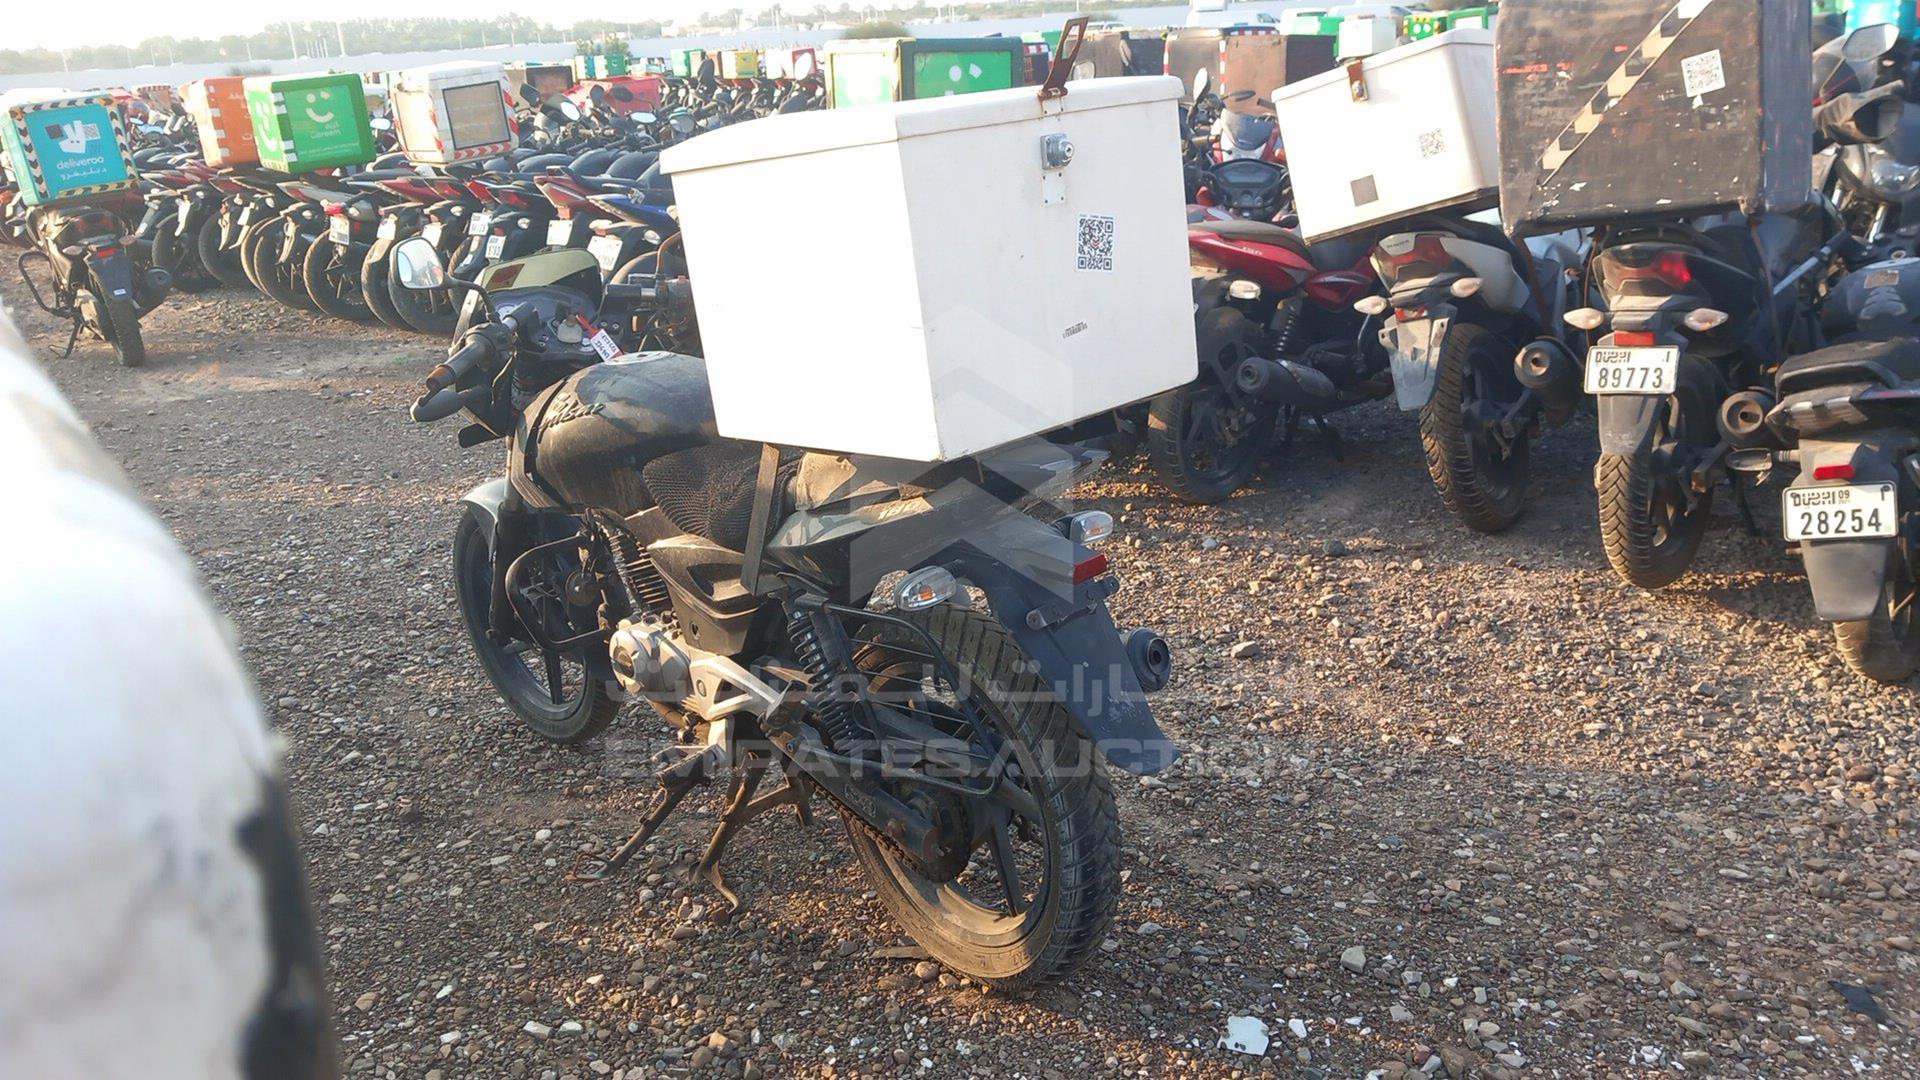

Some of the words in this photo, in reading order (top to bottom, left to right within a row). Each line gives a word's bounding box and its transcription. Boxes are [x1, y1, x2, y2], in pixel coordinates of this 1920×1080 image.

[56, 156, 104, 170] deliveroo
[1598, 367, 1663, 388] 89773
[1800, 508, 1882, 535] 28254
